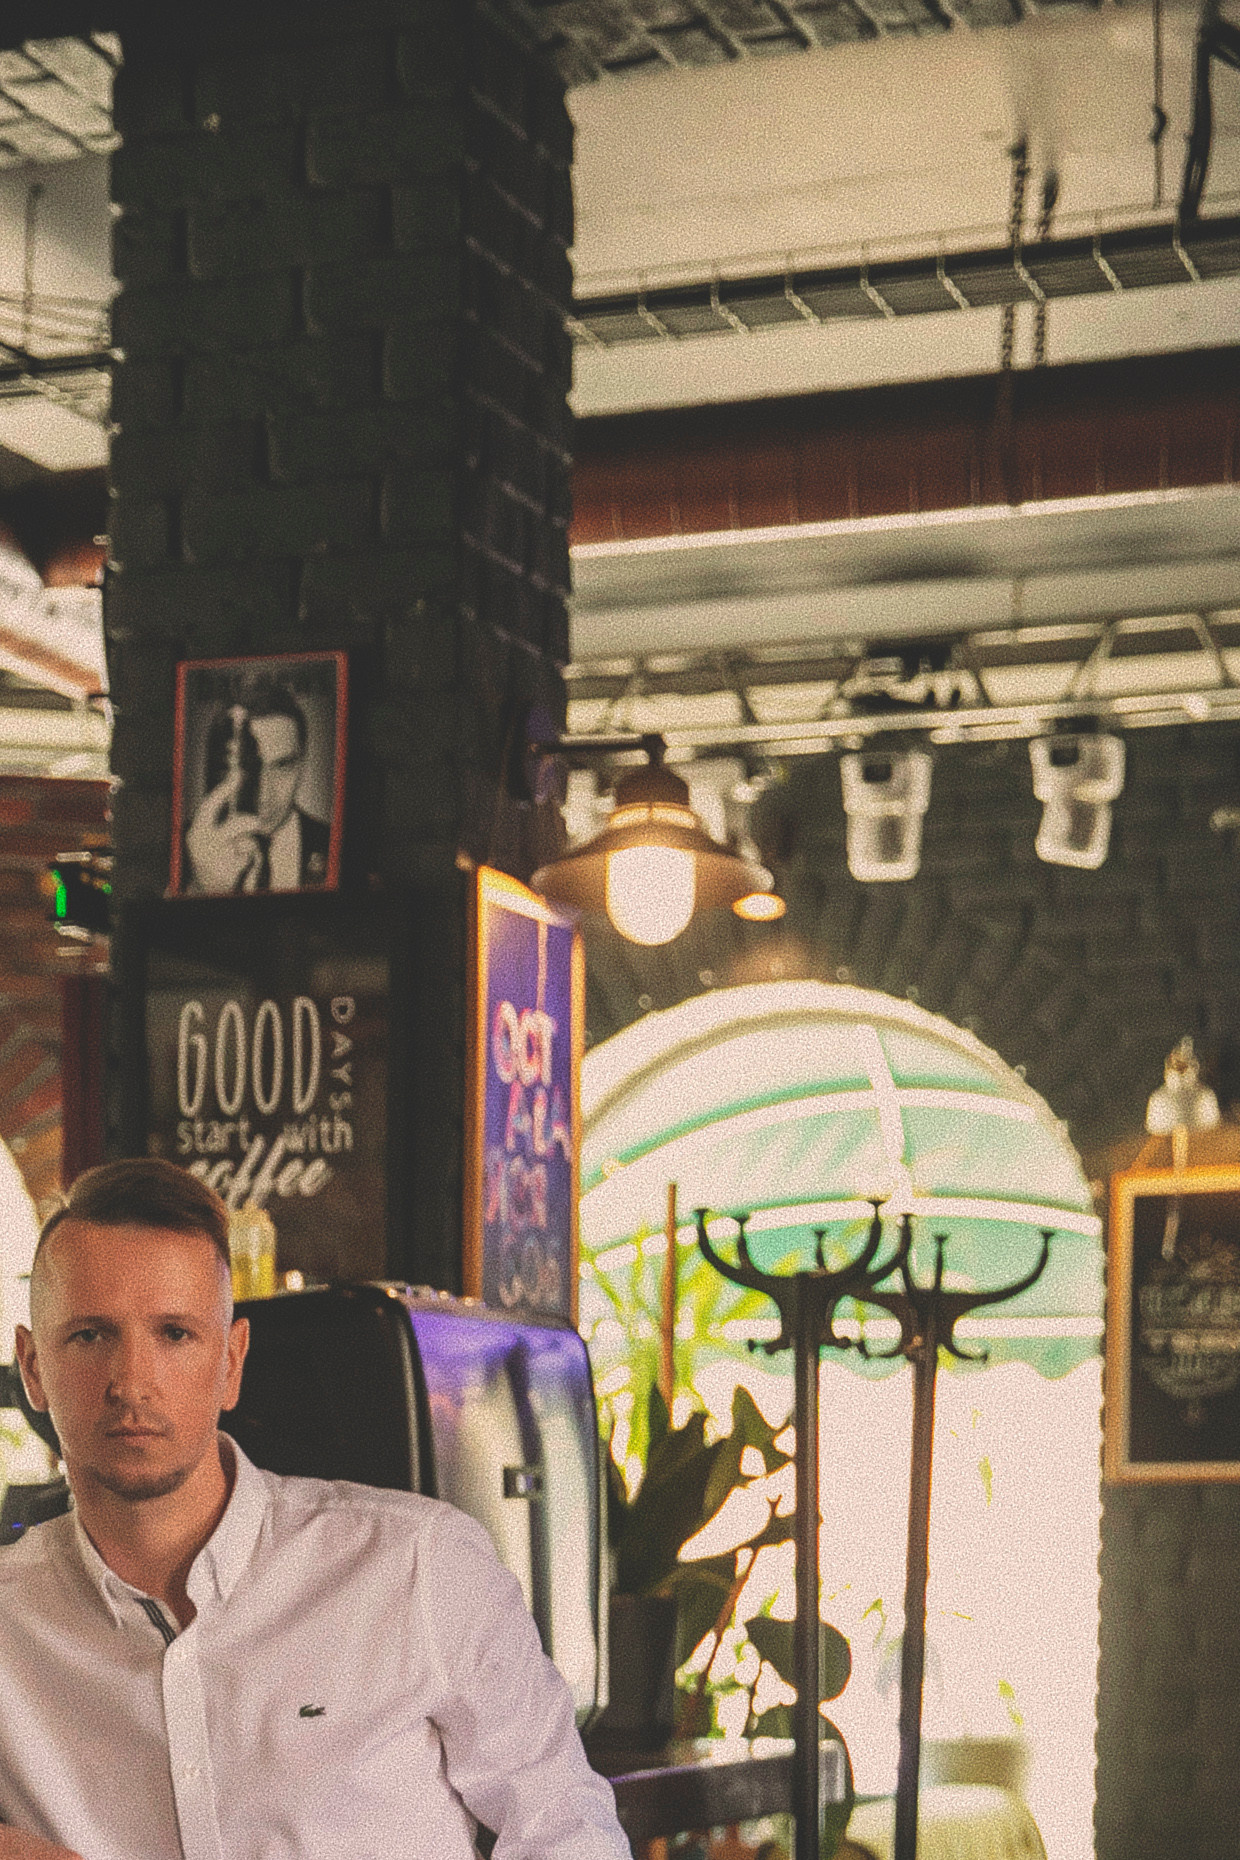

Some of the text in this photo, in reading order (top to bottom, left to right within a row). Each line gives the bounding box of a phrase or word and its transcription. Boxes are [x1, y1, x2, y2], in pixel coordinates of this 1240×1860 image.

[176, 996, 322, 1118] GOOD
[328, 996, 356, 1111] DAYS
[176, 1114, 354, 1154] start with
